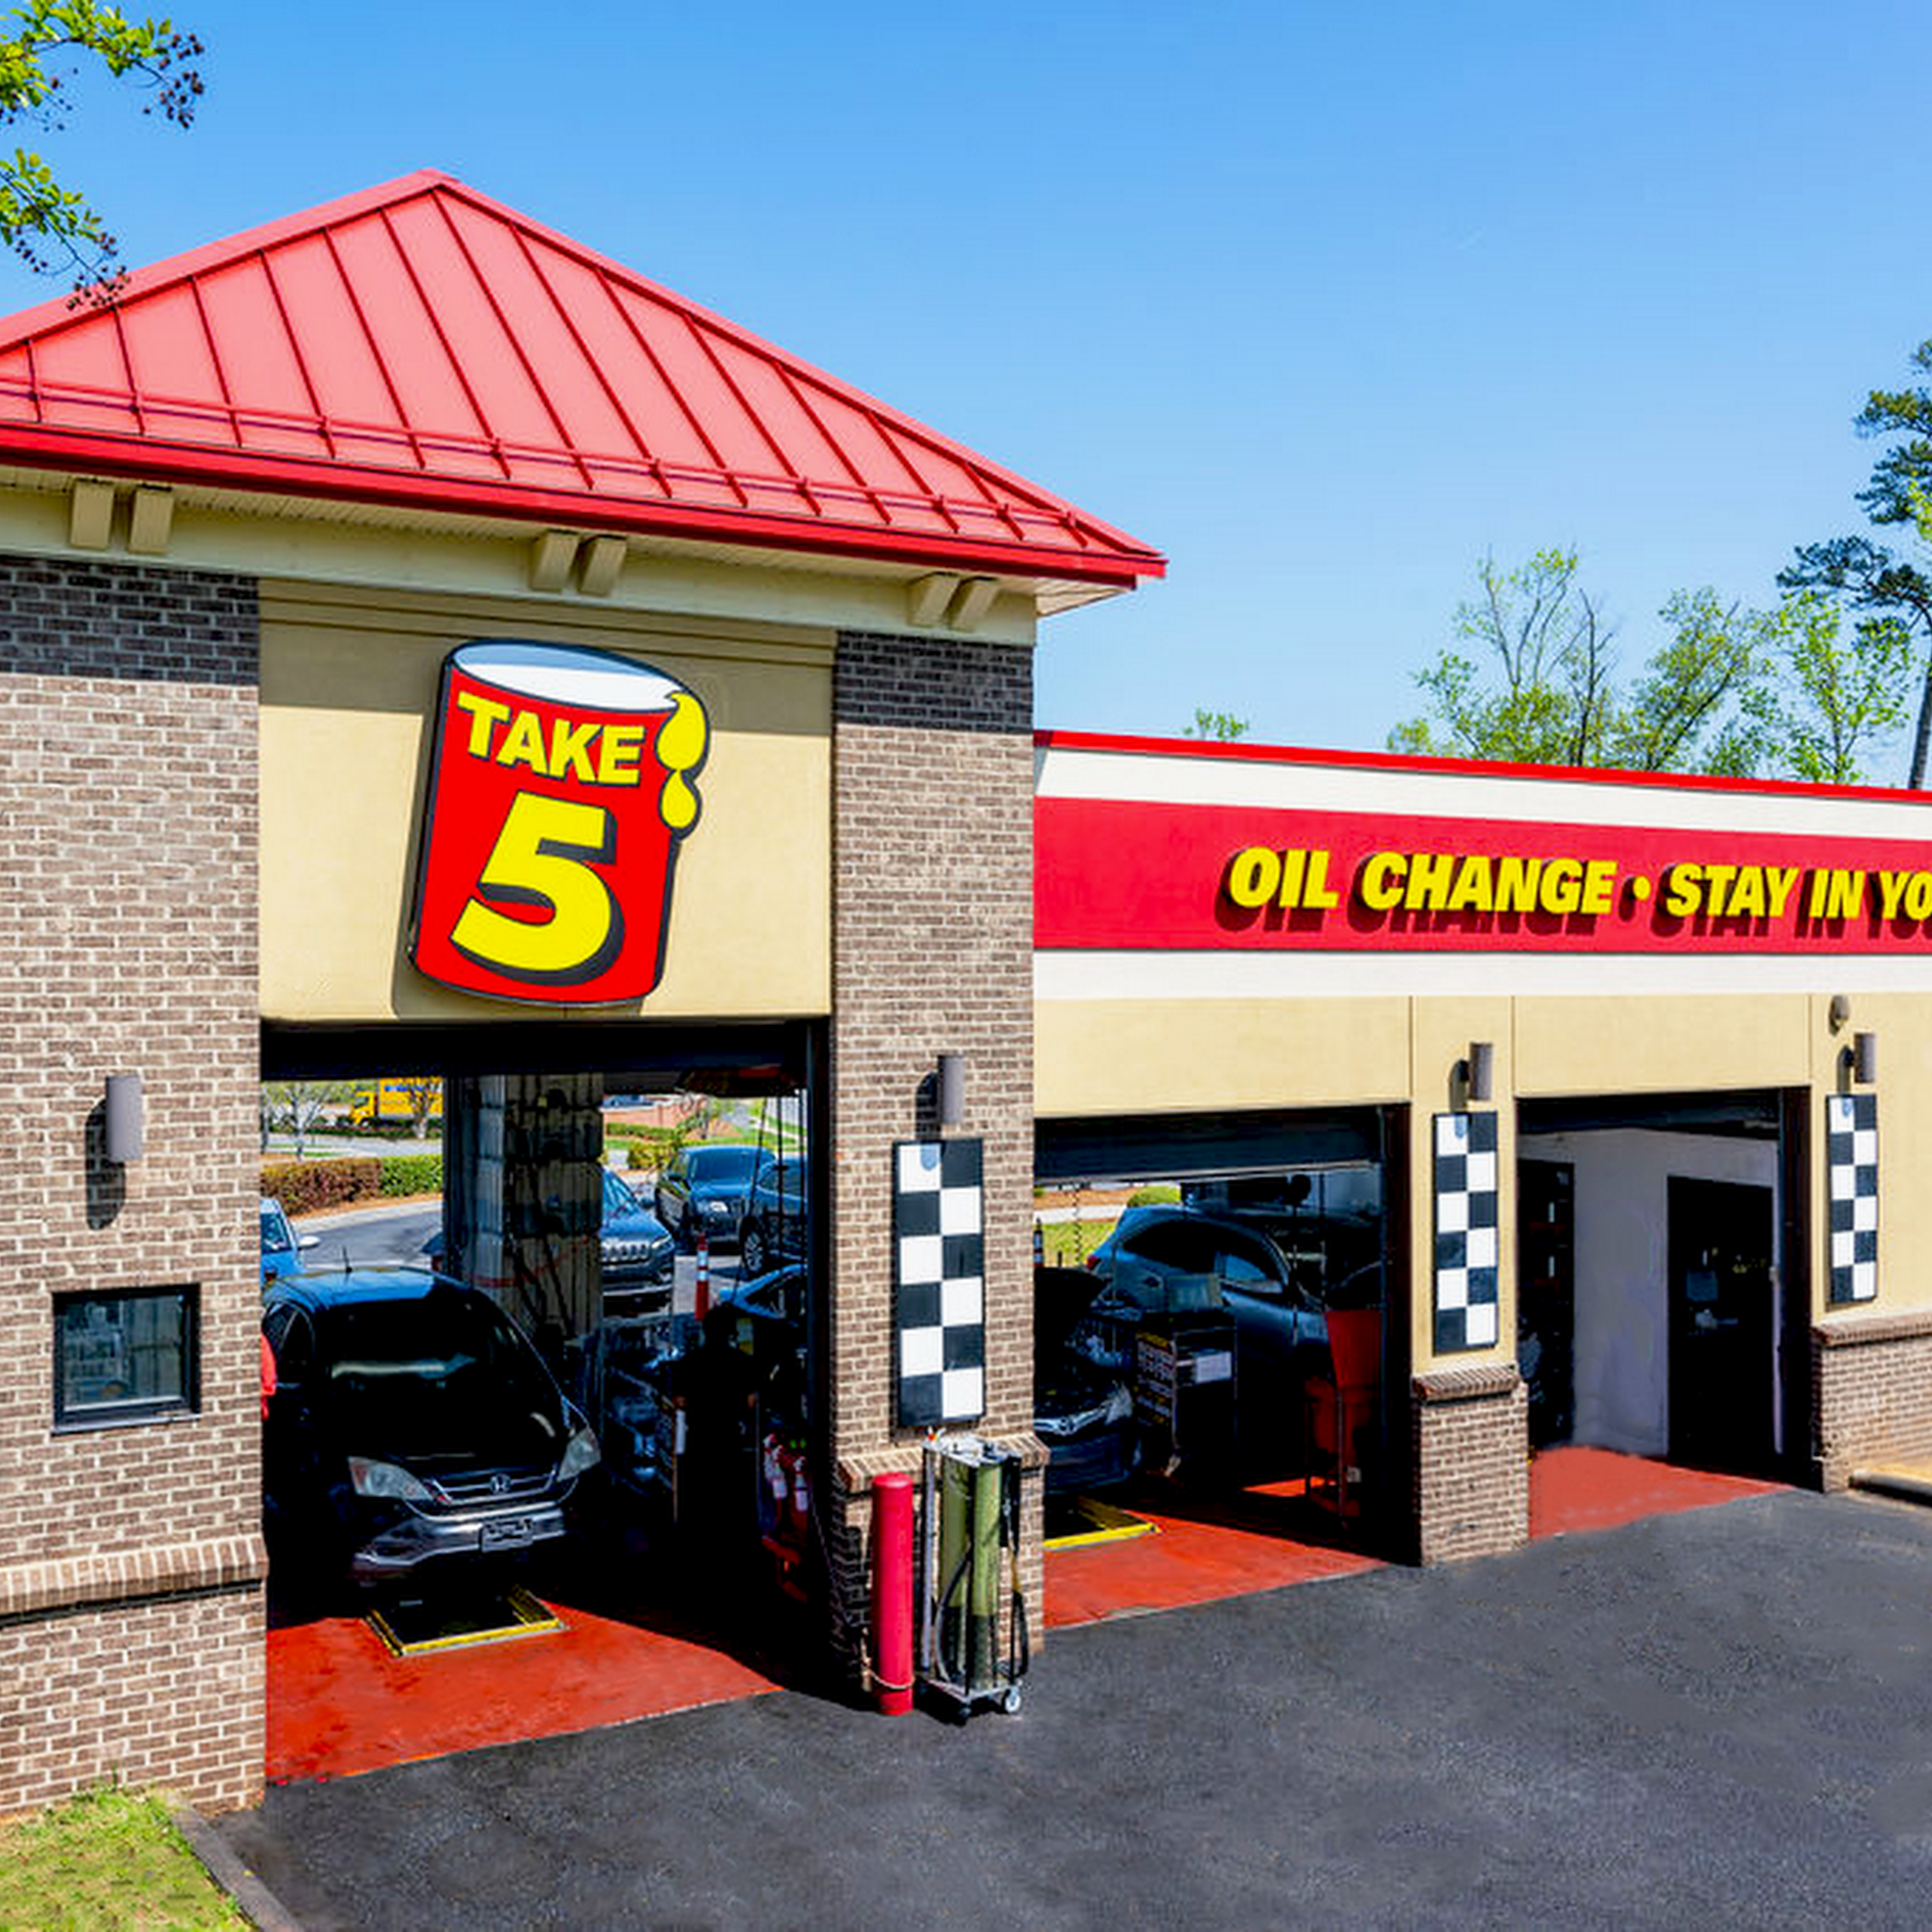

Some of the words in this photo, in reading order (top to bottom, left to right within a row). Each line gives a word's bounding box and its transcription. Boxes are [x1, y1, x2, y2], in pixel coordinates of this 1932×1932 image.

[457, 690, 645, 785] TAKE
[450, 791, 612, 972] 5
[1229, 846, 1339, 908] OIL
[1361, 851, 1618, 915] CHANGE
[1665, 863, 1800, 918] STAY
[1809, 868, 1866, 919] IN
